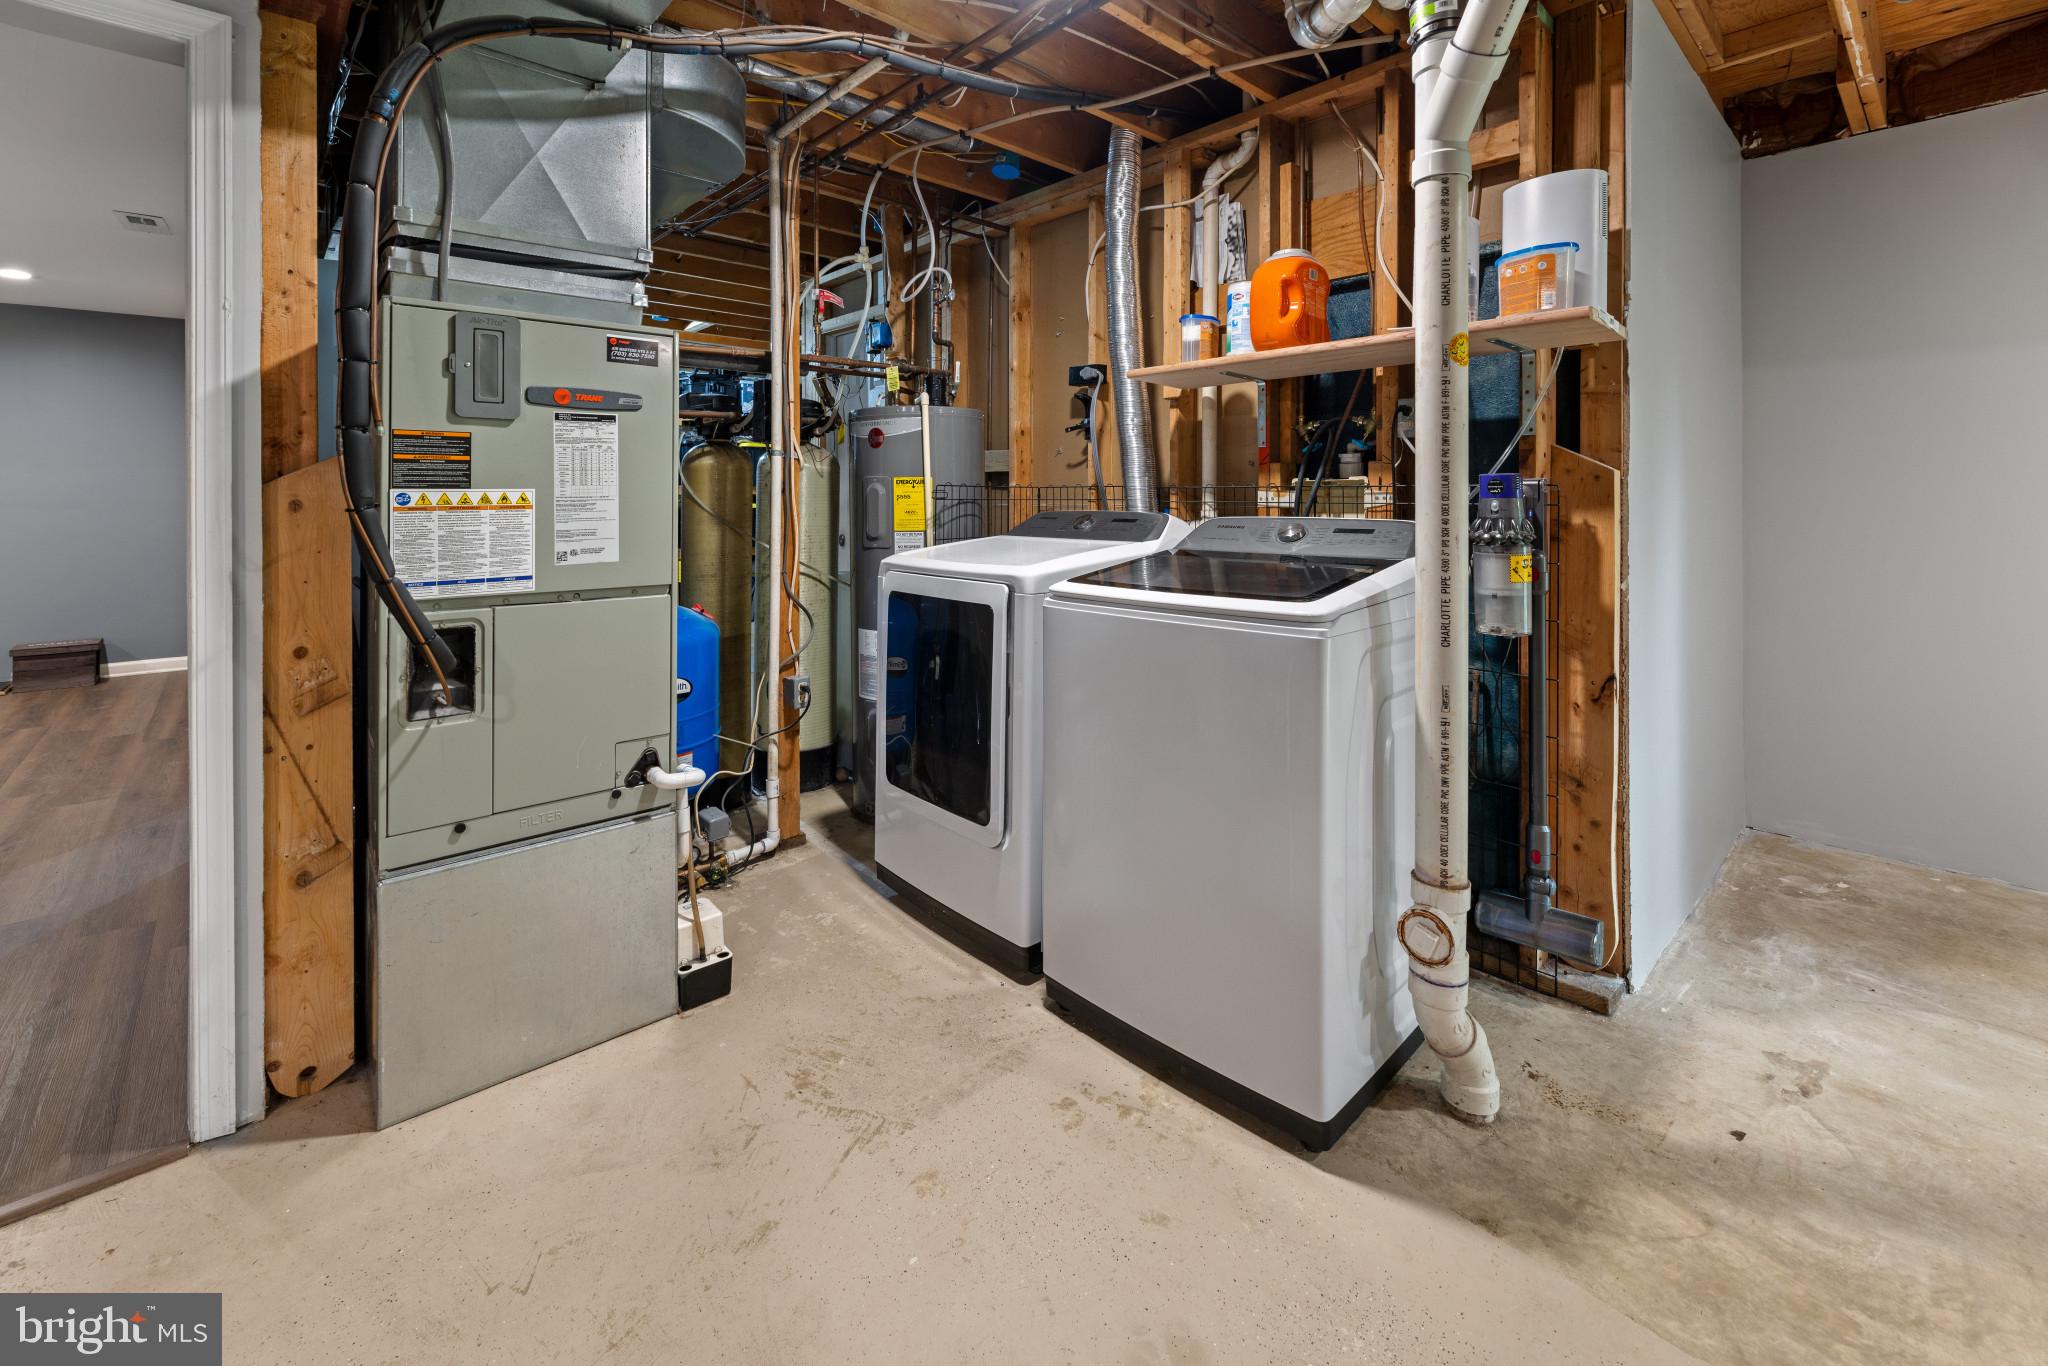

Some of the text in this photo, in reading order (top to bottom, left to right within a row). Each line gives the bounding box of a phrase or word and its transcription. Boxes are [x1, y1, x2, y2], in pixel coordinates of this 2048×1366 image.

[1441, 217, 1450, 232] 4300
[1441, 234, 1451, 253] PIPE
[575, 393, 605, 403] TRANE
[1441, 406, 1450, 420] ASTM
[1441, 422, 1450, 434] PIPE
[1441, 460, 1450, 474] CORE
[1441, 475, 1450, 501] CELLULAR
[1441, 518, 1450, 526] 40
[1441, 528, 1451, 538] SCH
[1441, 558, 1451, 573] 4300
[1441, 576, 1451, 594] PIPE
[1441, 598, 1451, 648] CHARLOTTE
[1441, 748, 1450, 761] ASTM
[1441, 801, 1450, 814] CORE
[519, 808, 562, 829] FILTER
[1441, 816, 1450, 842] CELLULAR
[1441, 858, 1450, 866] 40
